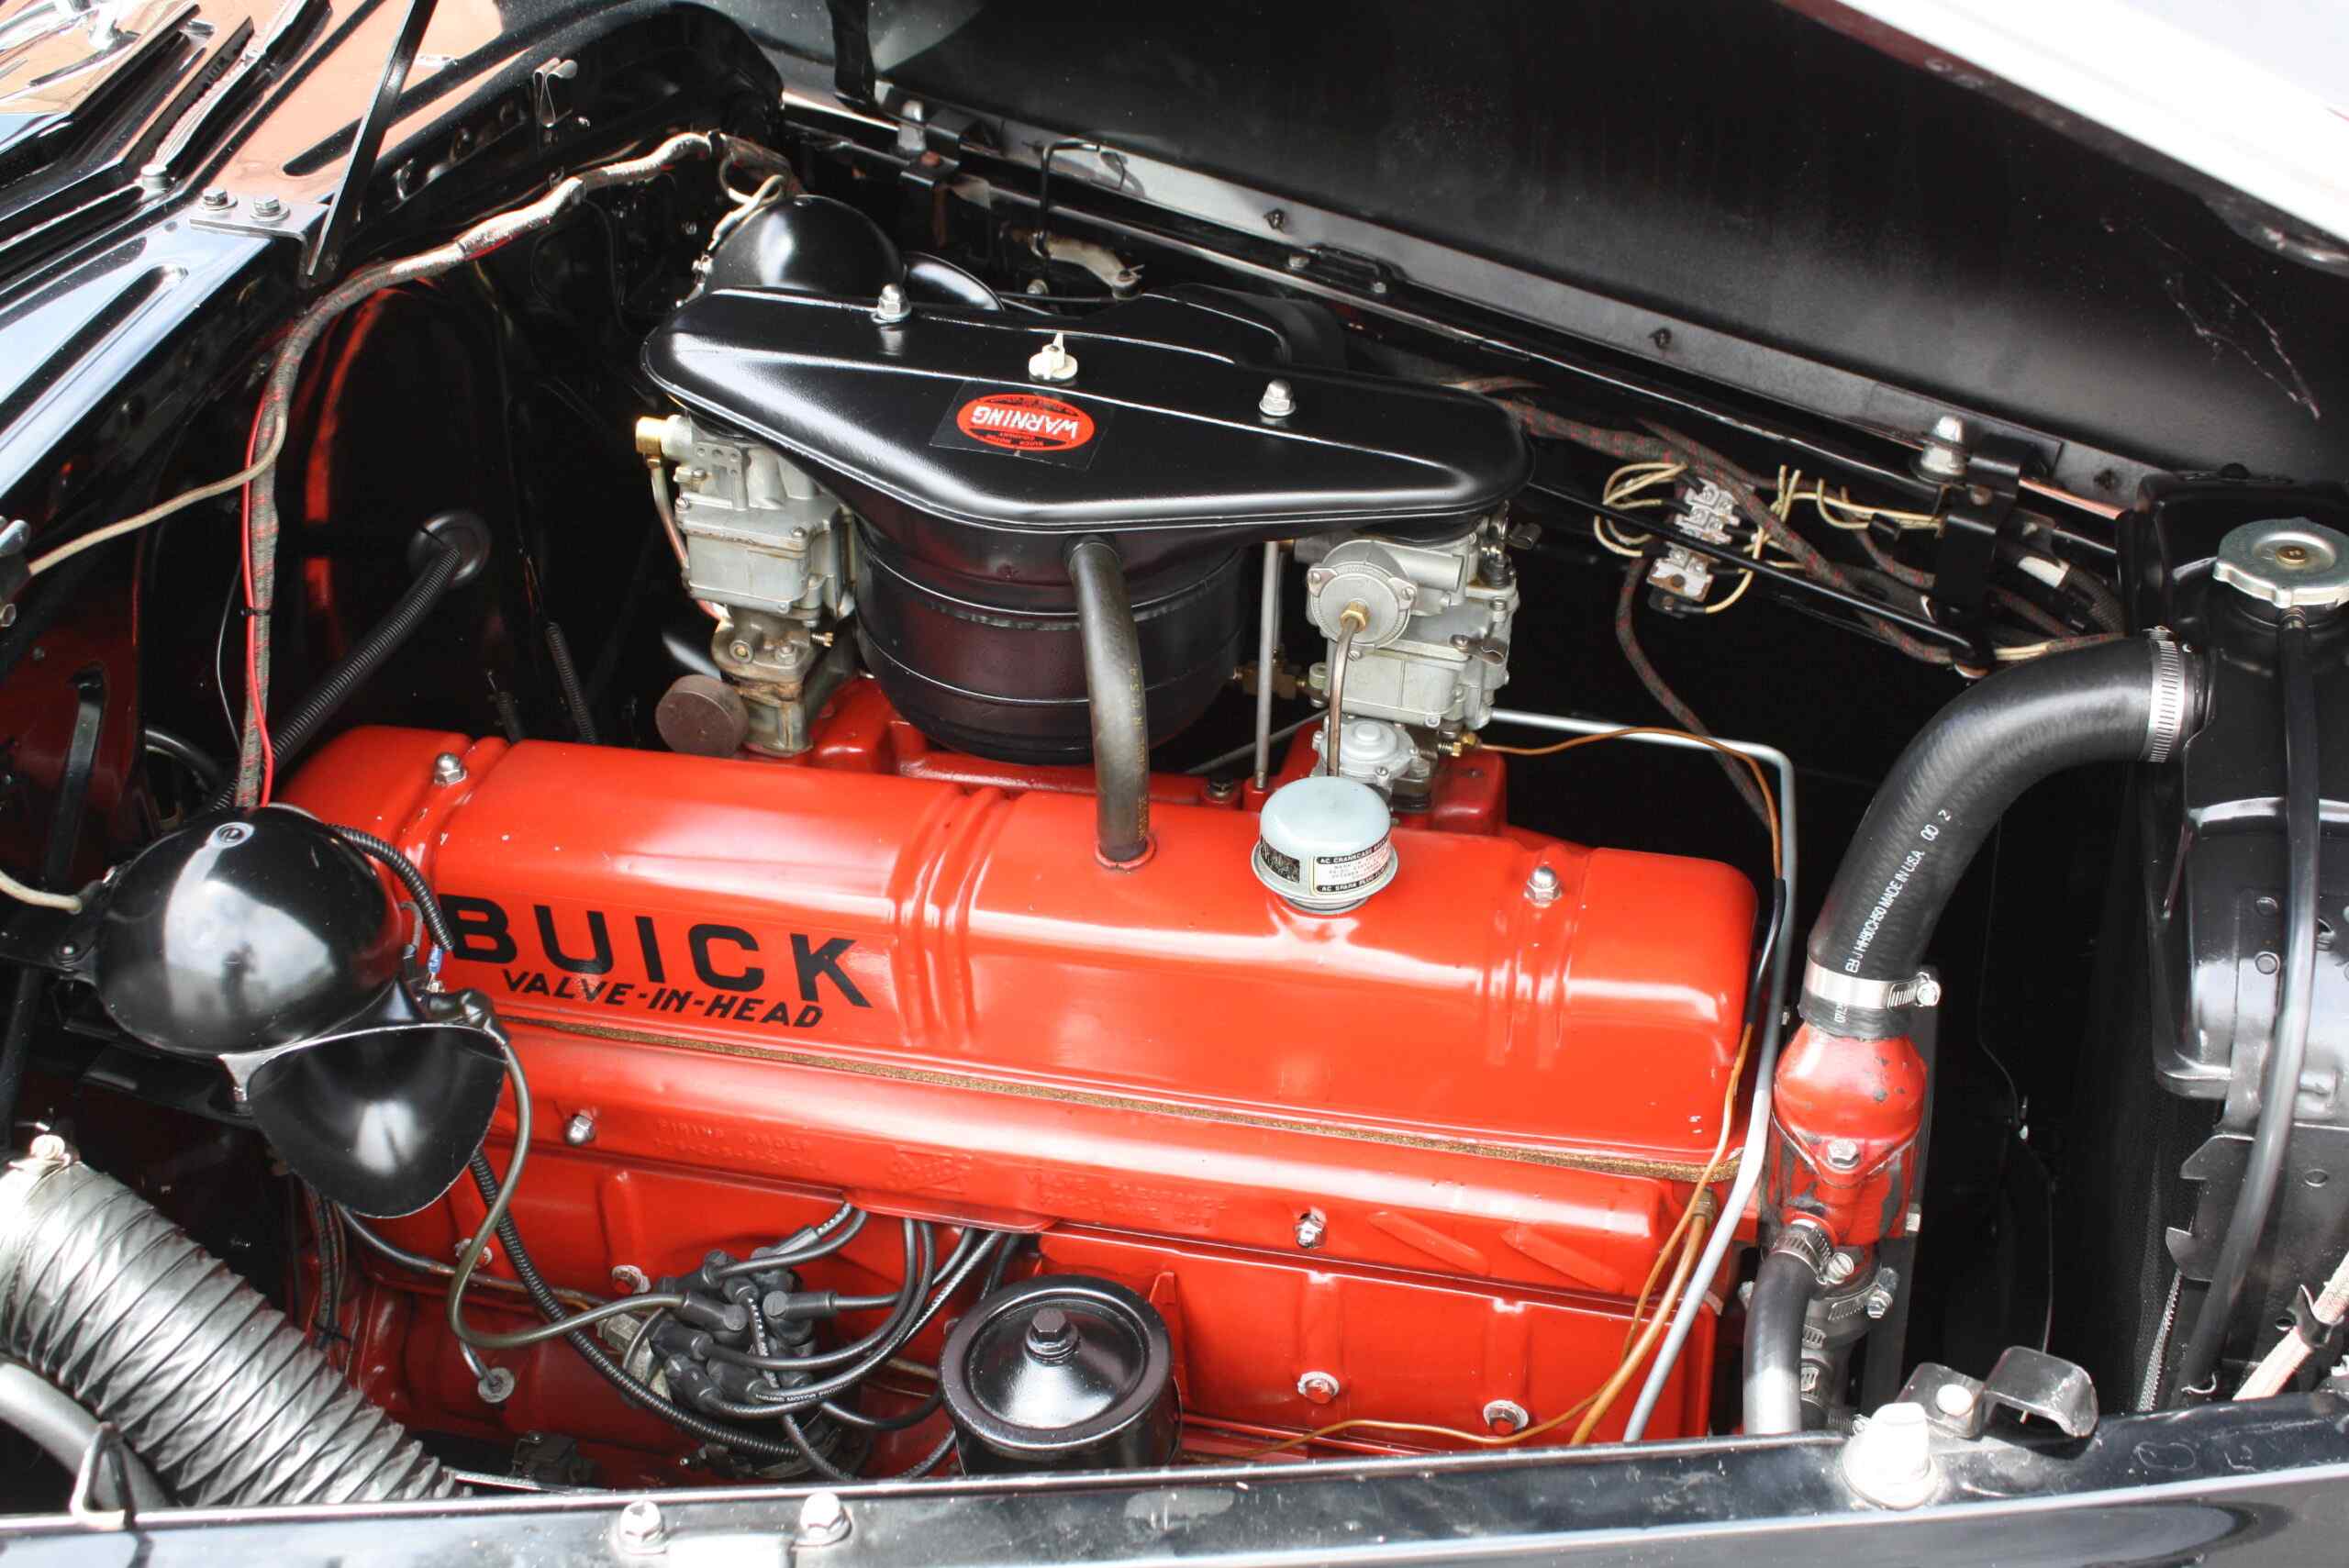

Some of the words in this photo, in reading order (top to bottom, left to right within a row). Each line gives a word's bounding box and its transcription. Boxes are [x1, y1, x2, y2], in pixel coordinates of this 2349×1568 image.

[971, 405, 1079, 439] WARNING
[1878, 879, 1903, 909] MADE
[1895, 869, 1909, 884] IN
[437, 894, 873, 1008] BUICK
[502, 968, 824, 1029] VALVE-IN-HEAD
